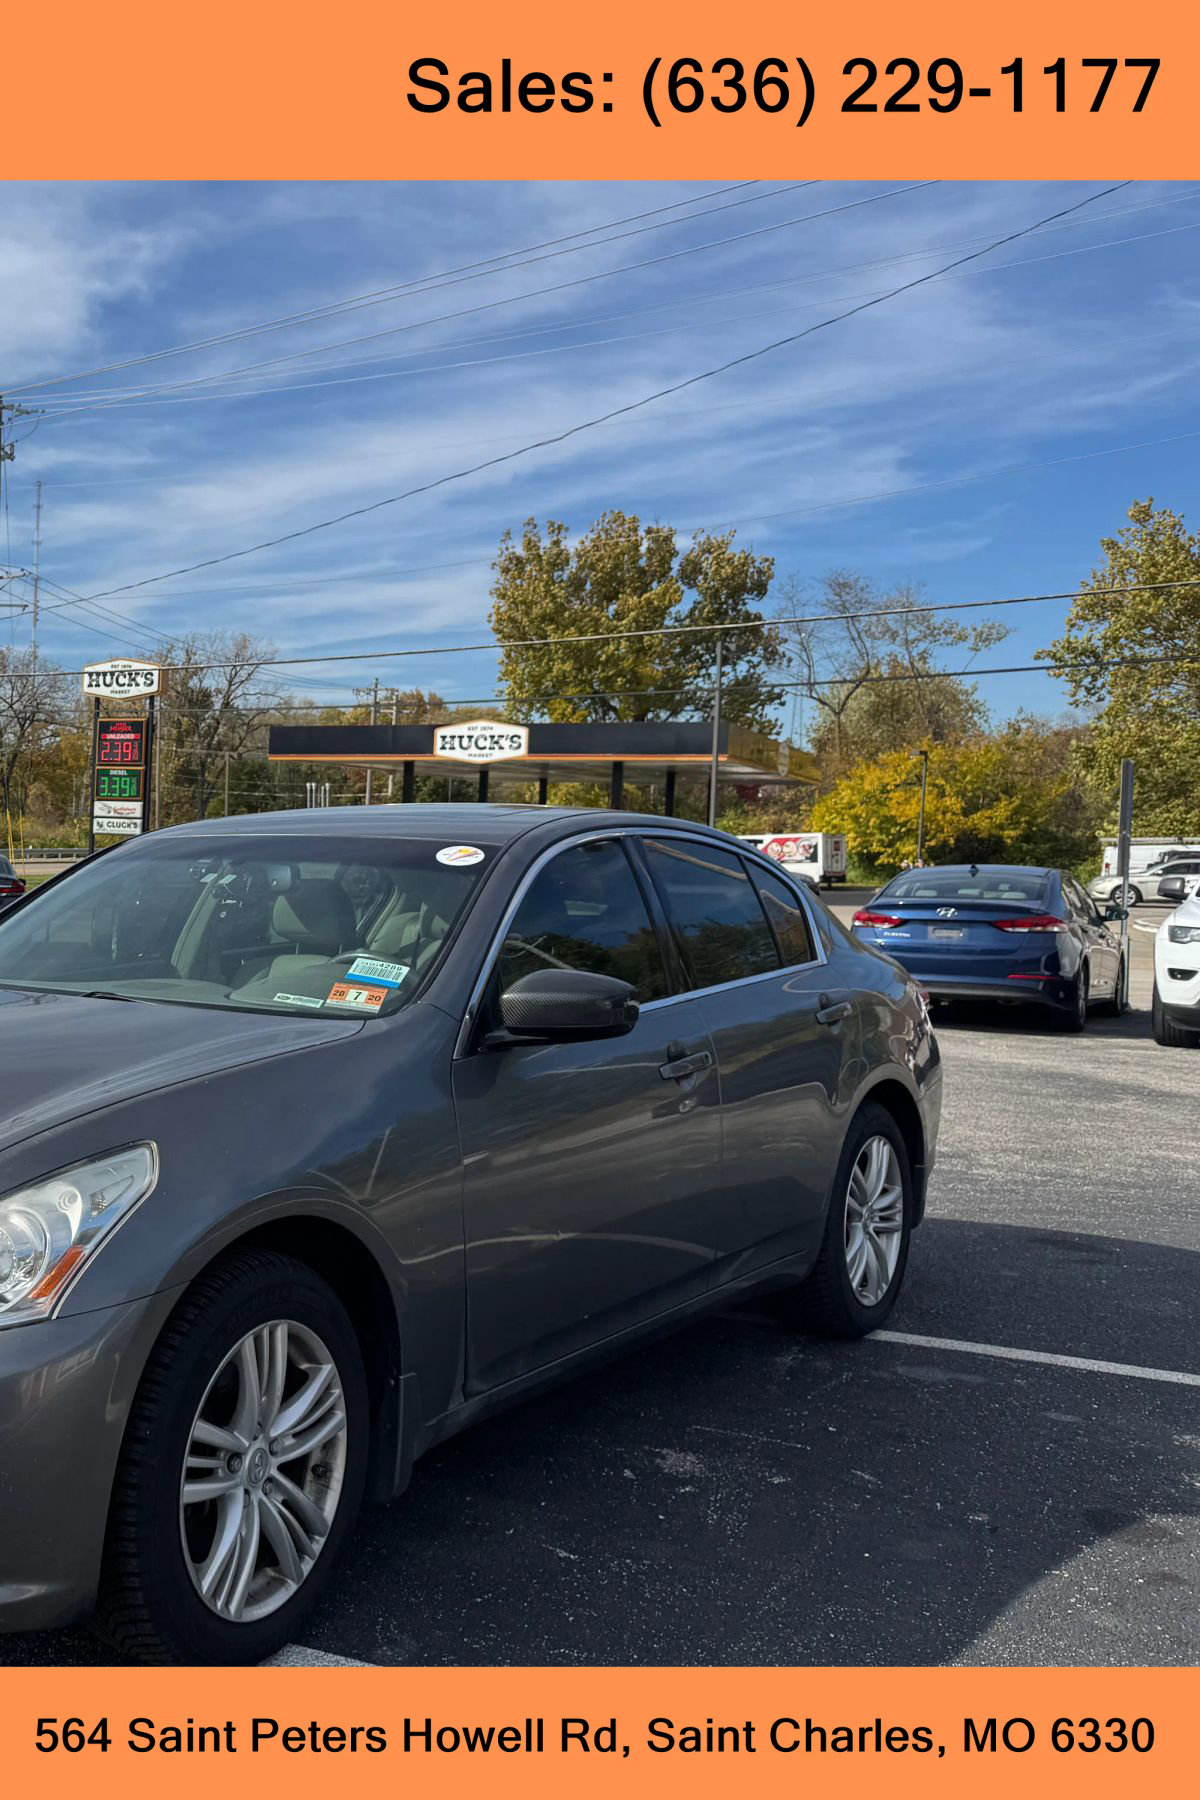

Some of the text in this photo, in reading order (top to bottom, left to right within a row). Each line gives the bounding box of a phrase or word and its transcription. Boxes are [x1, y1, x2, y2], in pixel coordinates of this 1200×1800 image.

[87, 671, 154, 688] HUCK'S
[439, 734, 522, 750] HUCK'S
[332, 989, 346, 997] 20
[353, 991, 362, 1001] 7
[367, 994, 382, 1002] 20
